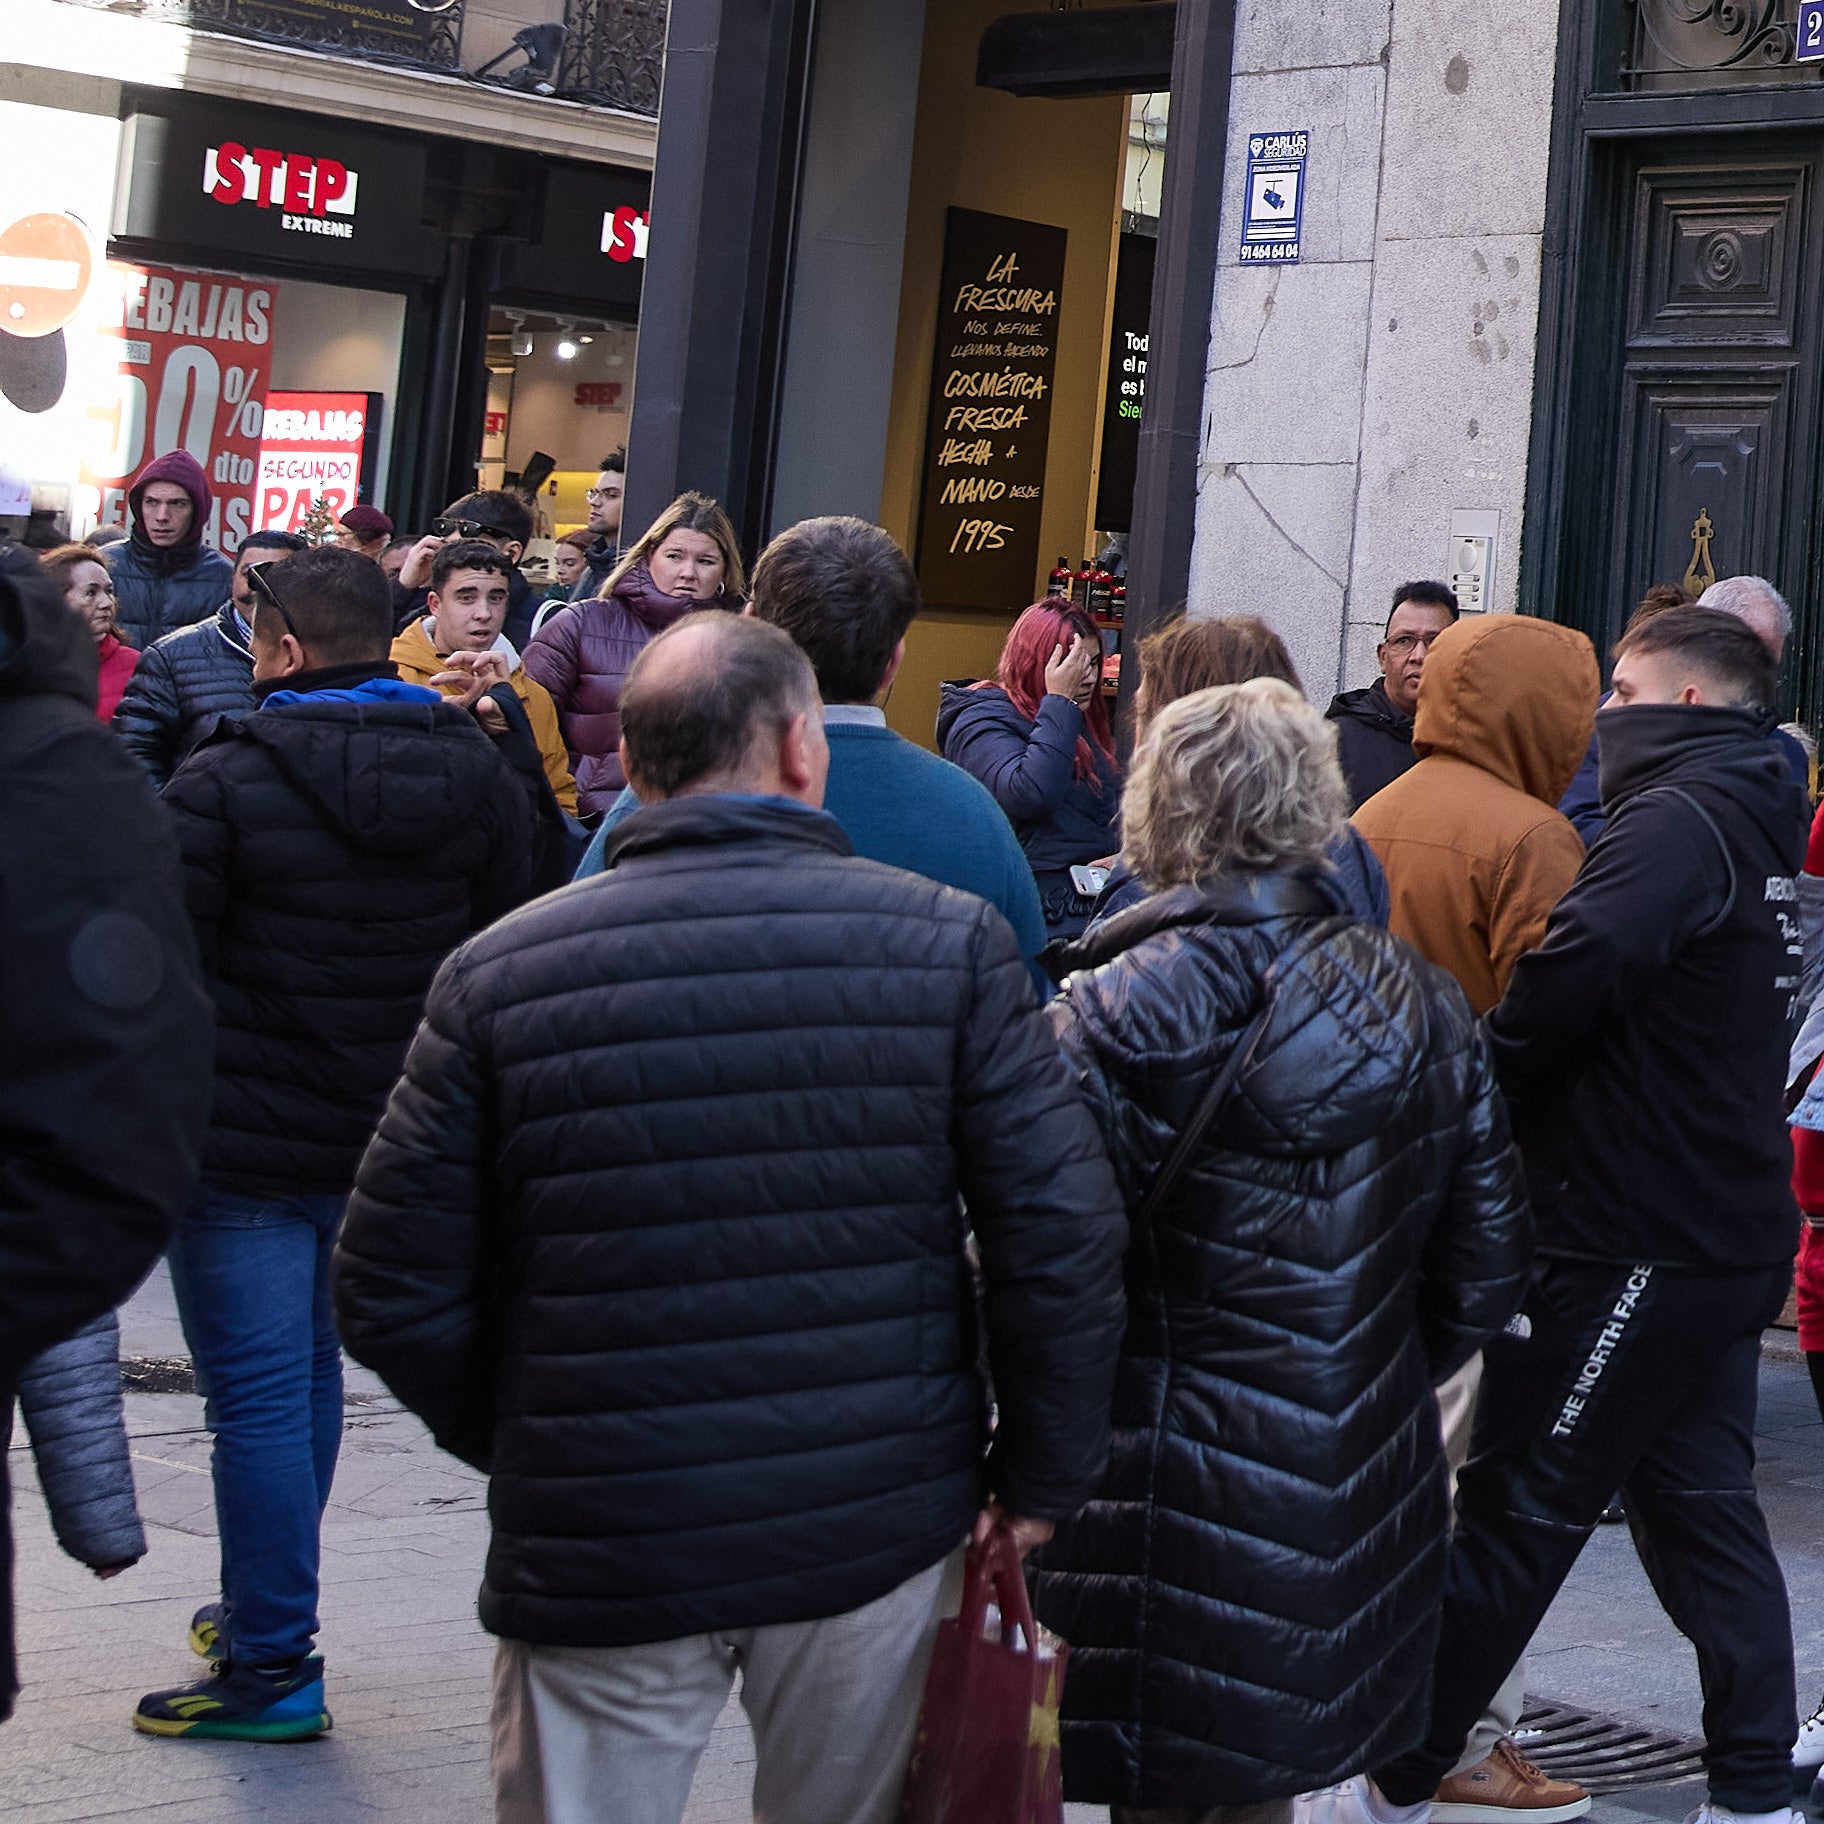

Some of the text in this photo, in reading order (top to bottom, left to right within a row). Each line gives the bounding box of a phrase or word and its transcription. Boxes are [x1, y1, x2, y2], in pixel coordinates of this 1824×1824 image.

[1264, 147, 1306, 158] SEGURIDAD
[1265, 132, 1306, 148] CARLÚS
[205, 141, 358, 217] STEP
[281, 213, 353, 239] EXTREME
[1241, 243, 1298, 259] 91 464 64 04
[986, 252, 1020, 284] LA
[110, 272, 270, 345] EBAJAS
[953, 284, 1056, 316] FRESCURA
[963, 320, 988, 336] NOS
[1124, 331, 1149, 351] Tod
[951, 344, 1001, 358] LLEVAMOS
[1123, 357, 1135, 372] el
[944, 365, 1048, 400] COSMÉTICA
[1121, 381, 1137, 396] es
[262, 408, 364, 442] REBAJAS
[944, 404, 1029, 433] FRESCA
[938, 438, 1018, 466] HECHA A
[214, 450, 254, 485] dto
[264, 460, 352, 480] SEGUNDO
[940, 477, 1007, 505] MANO
[262, 486, 347, 533] PAR
[950, 518, 1014, 553] 1995
[1551, 1264, 1654, 1436] THE NORTH FACE
